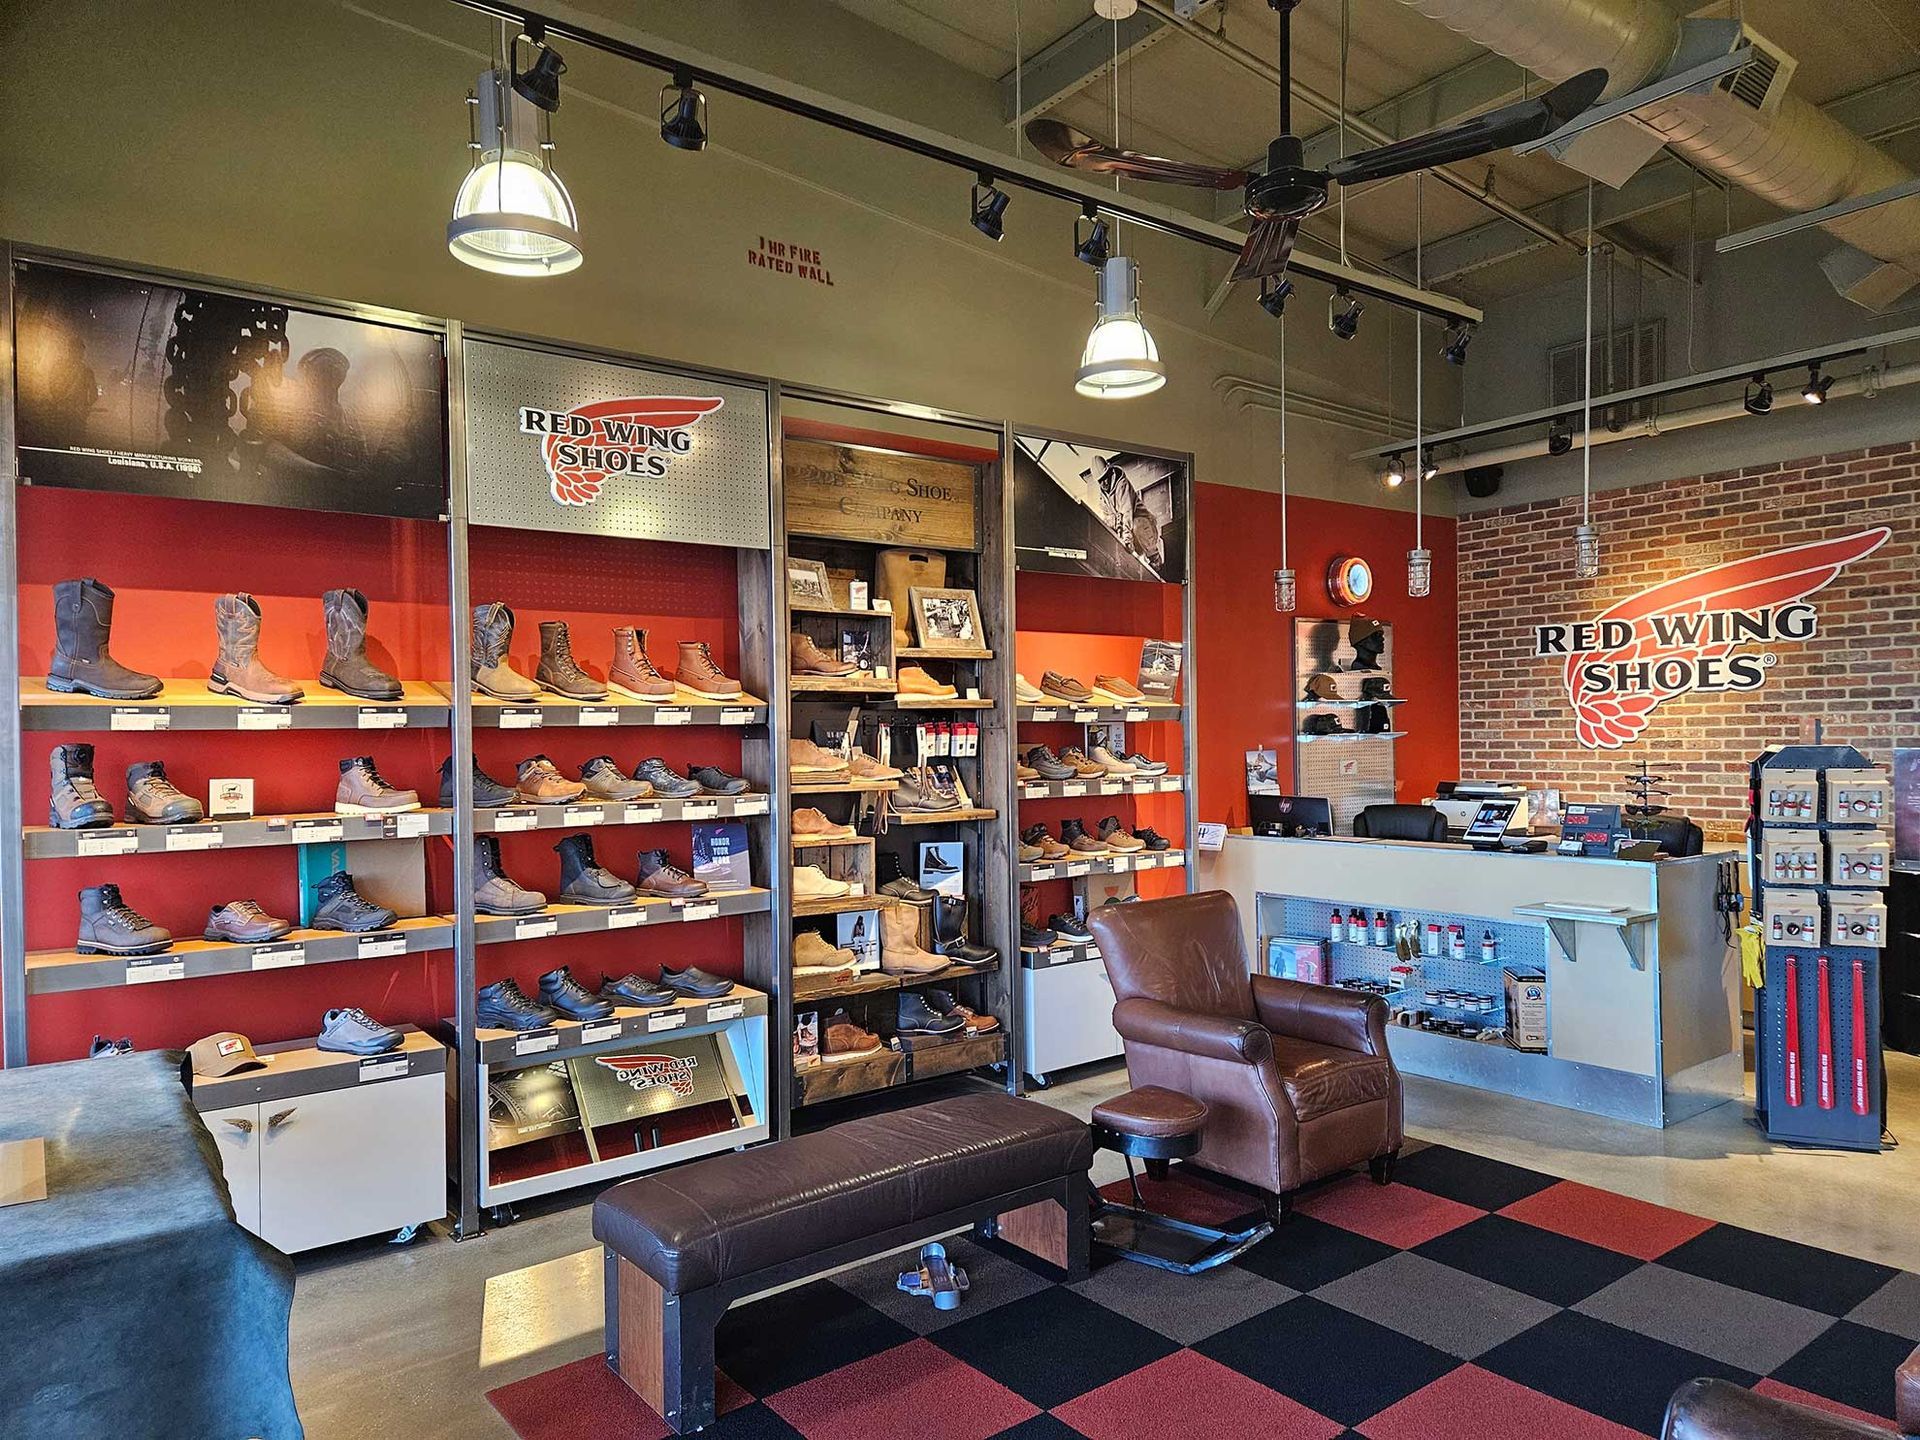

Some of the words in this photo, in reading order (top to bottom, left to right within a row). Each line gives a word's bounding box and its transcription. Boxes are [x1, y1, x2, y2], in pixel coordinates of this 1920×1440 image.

[768, 240, 785, 257] HR
[789, 245, 821, 266] FIRE
[748, 249, 793, 274] RATED
[798, 264, 834, 287] WALL
[525, 409, 592, 437] RED
[602, 418, 690, 452] WING
[108, 457, 149, 468] Louisiana,
[839, 496, 923, 523] CPANY
[1539, 621, 1633, 654] RED
[1650, 605, 1816, 646] WING
[710, 837, 730, 846] HONOR
[713, 847, 729, 855] YOUR
[711, 856, 730, 864] WORK
